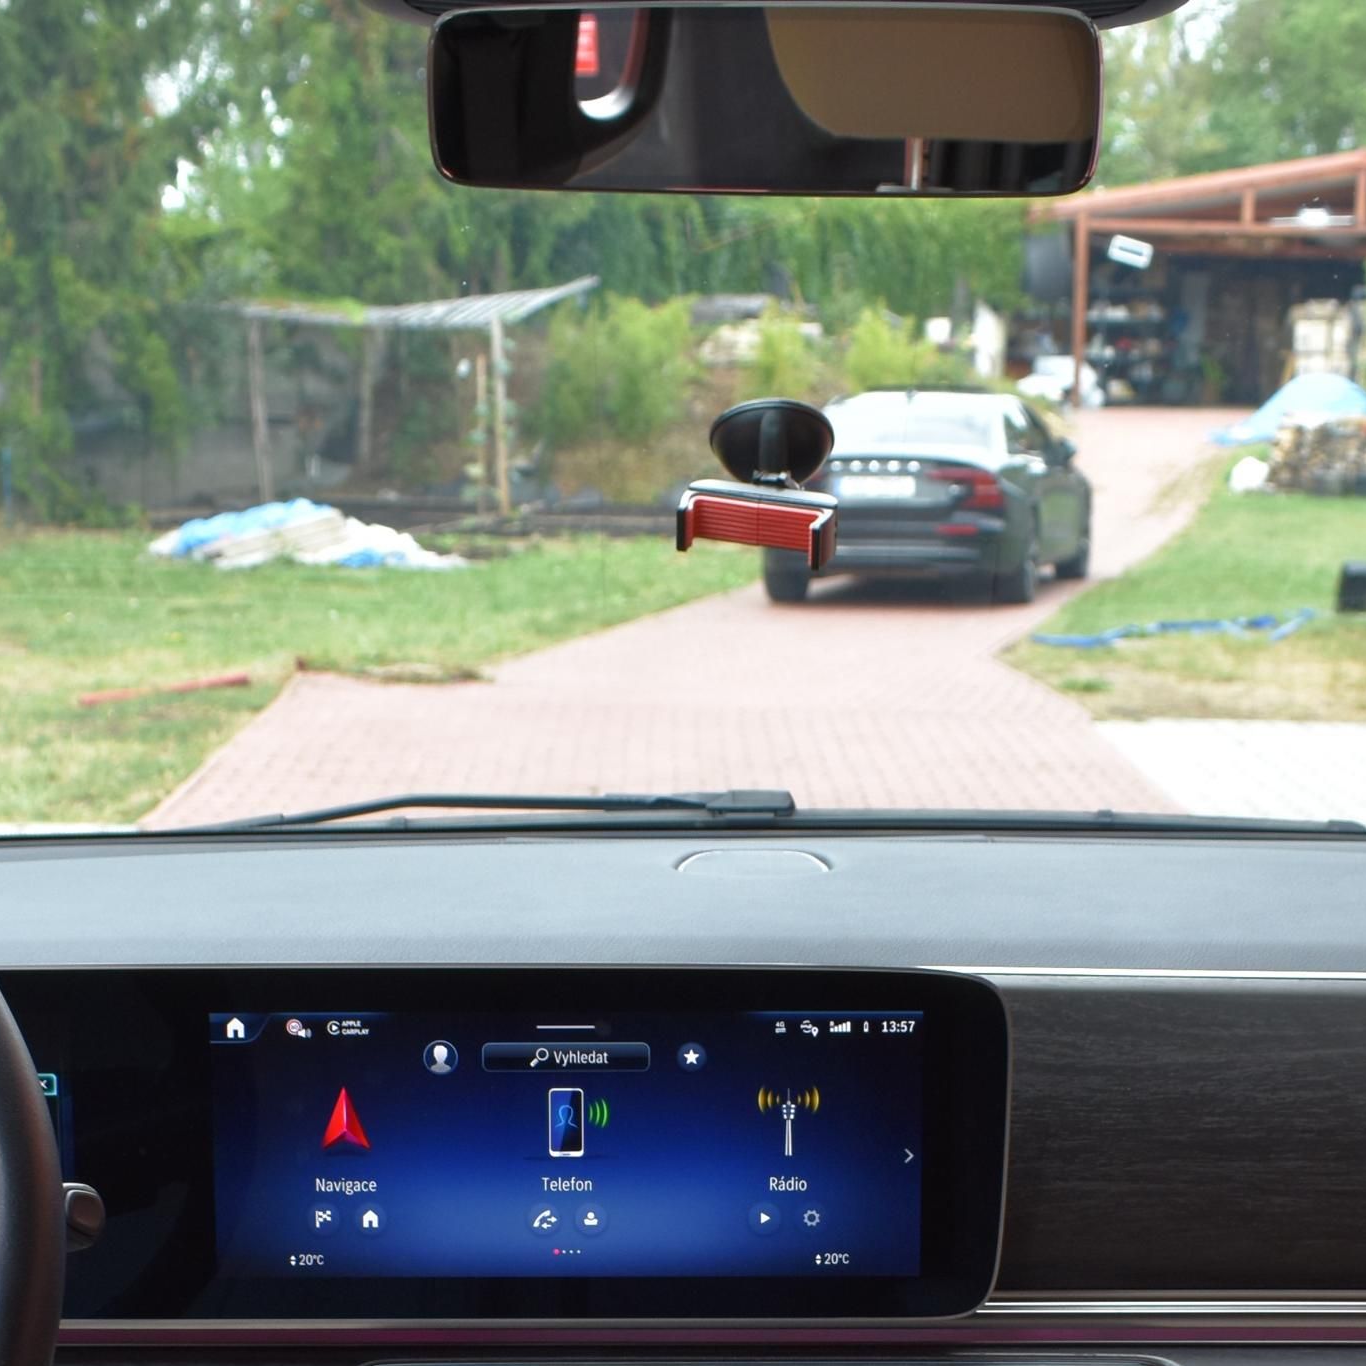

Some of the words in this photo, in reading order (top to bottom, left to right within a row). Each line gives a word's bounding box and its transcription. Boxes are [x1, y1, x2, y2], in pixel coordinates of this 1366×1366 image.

[881, 1021, 916, 1033] 13:57
[553, 1050, 609, 1067] Vyhledat
[315, 1178, 377, 1195] Navigace
[541, 1177, 593, 1191] Telefon
[769, 1176, 807, 1191] Rádio
[299, 1254, 324, 1266] 20°C
[824, 1253, 850, 1265] 20°C
